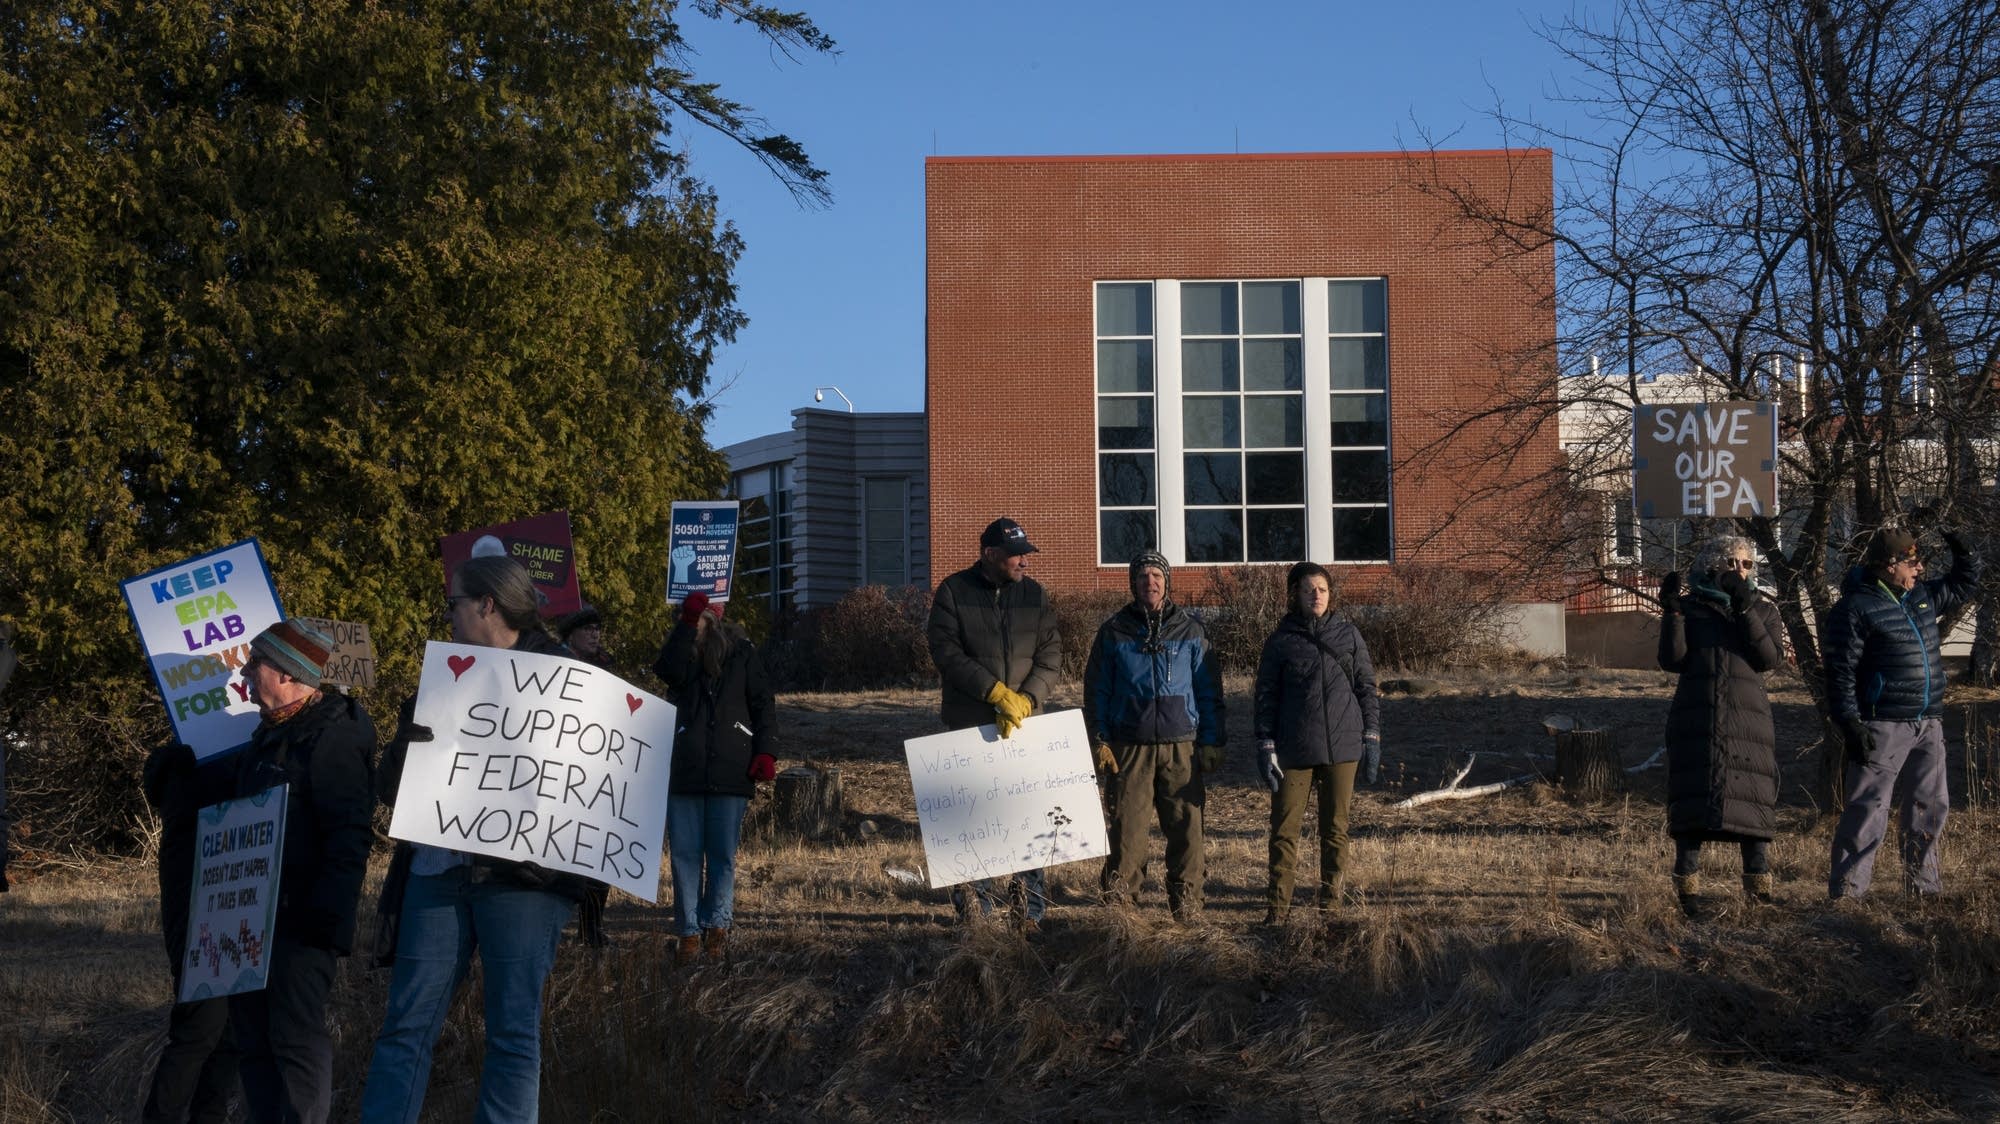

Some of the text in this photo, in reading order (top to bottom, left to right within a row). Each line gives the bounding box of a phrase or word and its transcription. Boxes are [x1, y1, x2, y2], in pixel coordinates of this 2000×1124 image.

[1652, 408, 1753, 446] SAVE
[1674, 450, 1736, 480] OUR
[1681, 477, 1761, 517] EPA
[674, 524, 706, 535] 50501:
[511, 542, 565, 563] SHAME
[529, 559, 543, 569] ON
[696, 562, 729, 571] APRIL 5TH
[697, 554, 731, 563] SATURDAY
[150, 559, 234, 604] KEEP
[175, 590, 238, 626] EPA
[183, 614, 246, 651] LAB
[161, 643, 250, 691] WORKI
[321, 654, 370, 686] USK-RAT
[510, 658, 592, 703] WE
[173, 686, 231, 722] FOR
[460, 702, 652, 773] SUPPORT
[919, 736, 1071, 774] Water is life and
[448, 752, 639, 828] FEDERAL
[919, 784, 978, 822] quality
[986, 776, 1000, 801] of
[1004, 780, 1040, 797] water
[202, 819, 274, 858] CLEAN WATER
[436, 800, 648, 880] WORKERS
[931, 832, 950, 849] the
[958, 816, 1010, 851] quality
[202, 860, 230, 887] DOESN'T
[208, 885, 258, 912] IT TAKES WORK.
